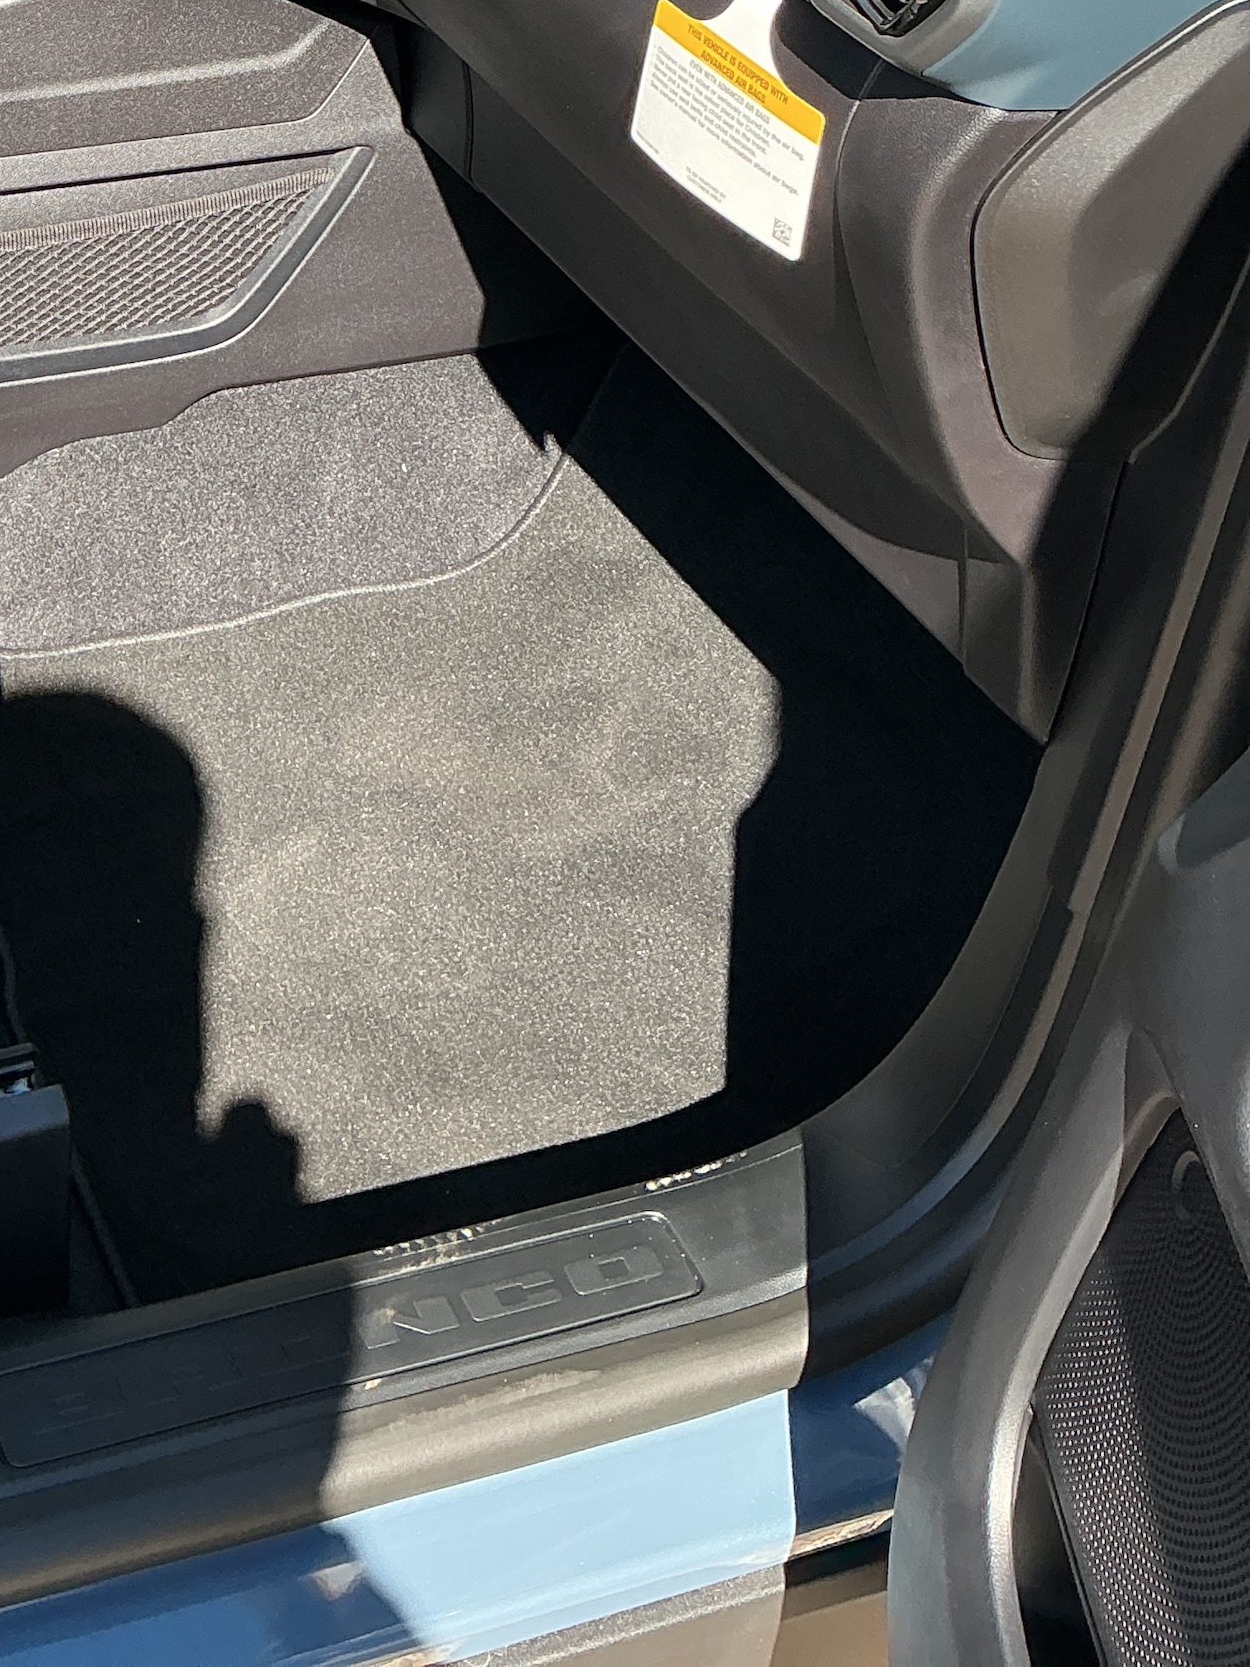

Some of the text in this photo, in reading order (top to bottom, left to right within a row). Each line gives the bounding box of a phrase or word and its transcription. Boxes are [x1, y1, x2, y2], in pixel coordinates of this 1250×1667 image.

[655, 53, 665, 66] The
[694, 84, 703, 97] the
[735, 116, 744, 129] for
[656, 44, 678, 67] Children
[677, 62, 688, 75] can
[761, 125, 771, 139] by
[770, 131, 781, 145] the
[781, 139, 791, 152] air
[686, 22, 788, 106] THIS VEHICLE IS EQUIPPED WITH
[689, 58, 770, 126] EVEN WITH ADVANCED AIR BAGS
[699, 47, 766, 105] ADVANCED AIR BAGS
[32, 1245, 664, 1438] BRONCO
